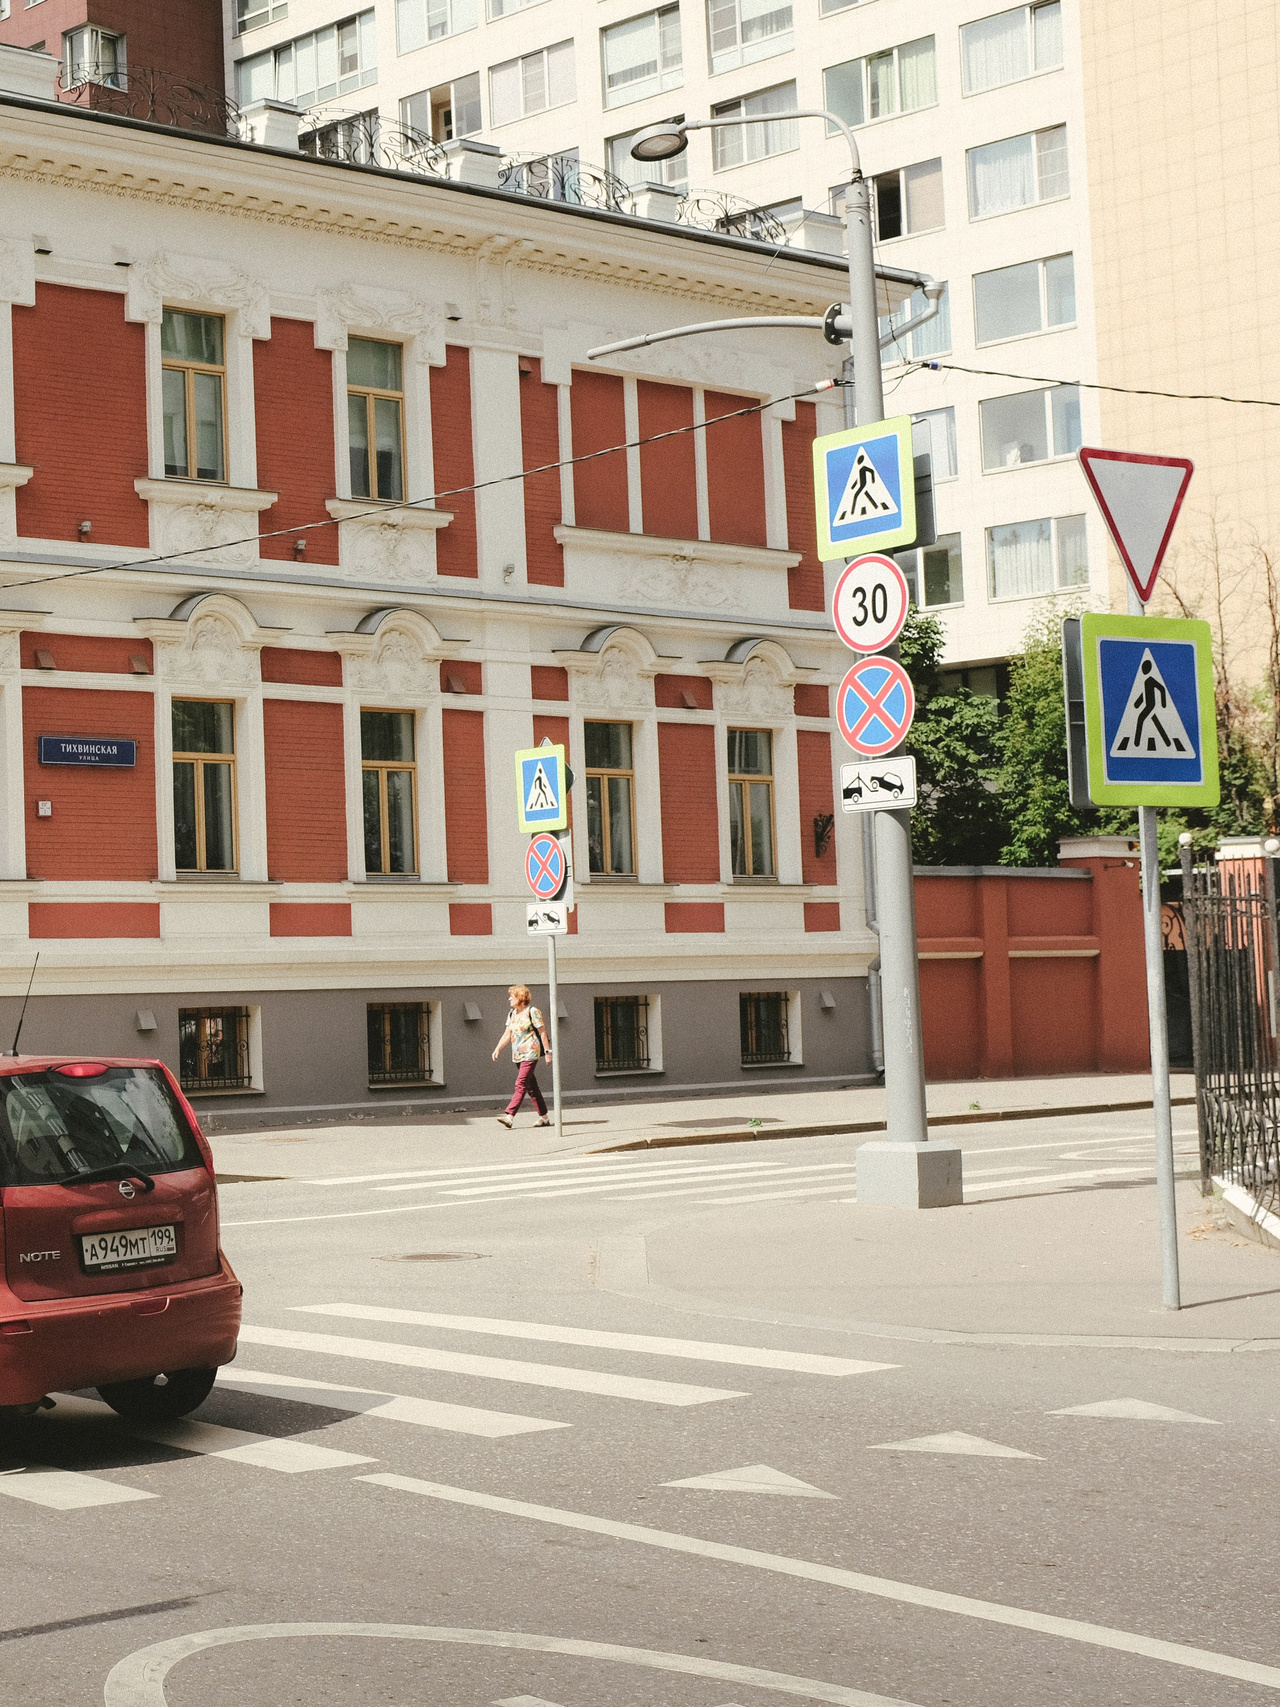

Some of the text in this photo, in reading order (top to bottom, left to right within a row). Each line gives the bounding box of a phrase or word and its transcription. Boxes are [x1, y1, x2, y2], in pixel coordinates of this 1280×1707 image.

[852, 583, 888, 627] 30
[60, 743, 118, 755] ТИХВИНСКАЯ
[150, 1228, 171, 1246] 199
[20, 1250, 61, 1263] NOTE
